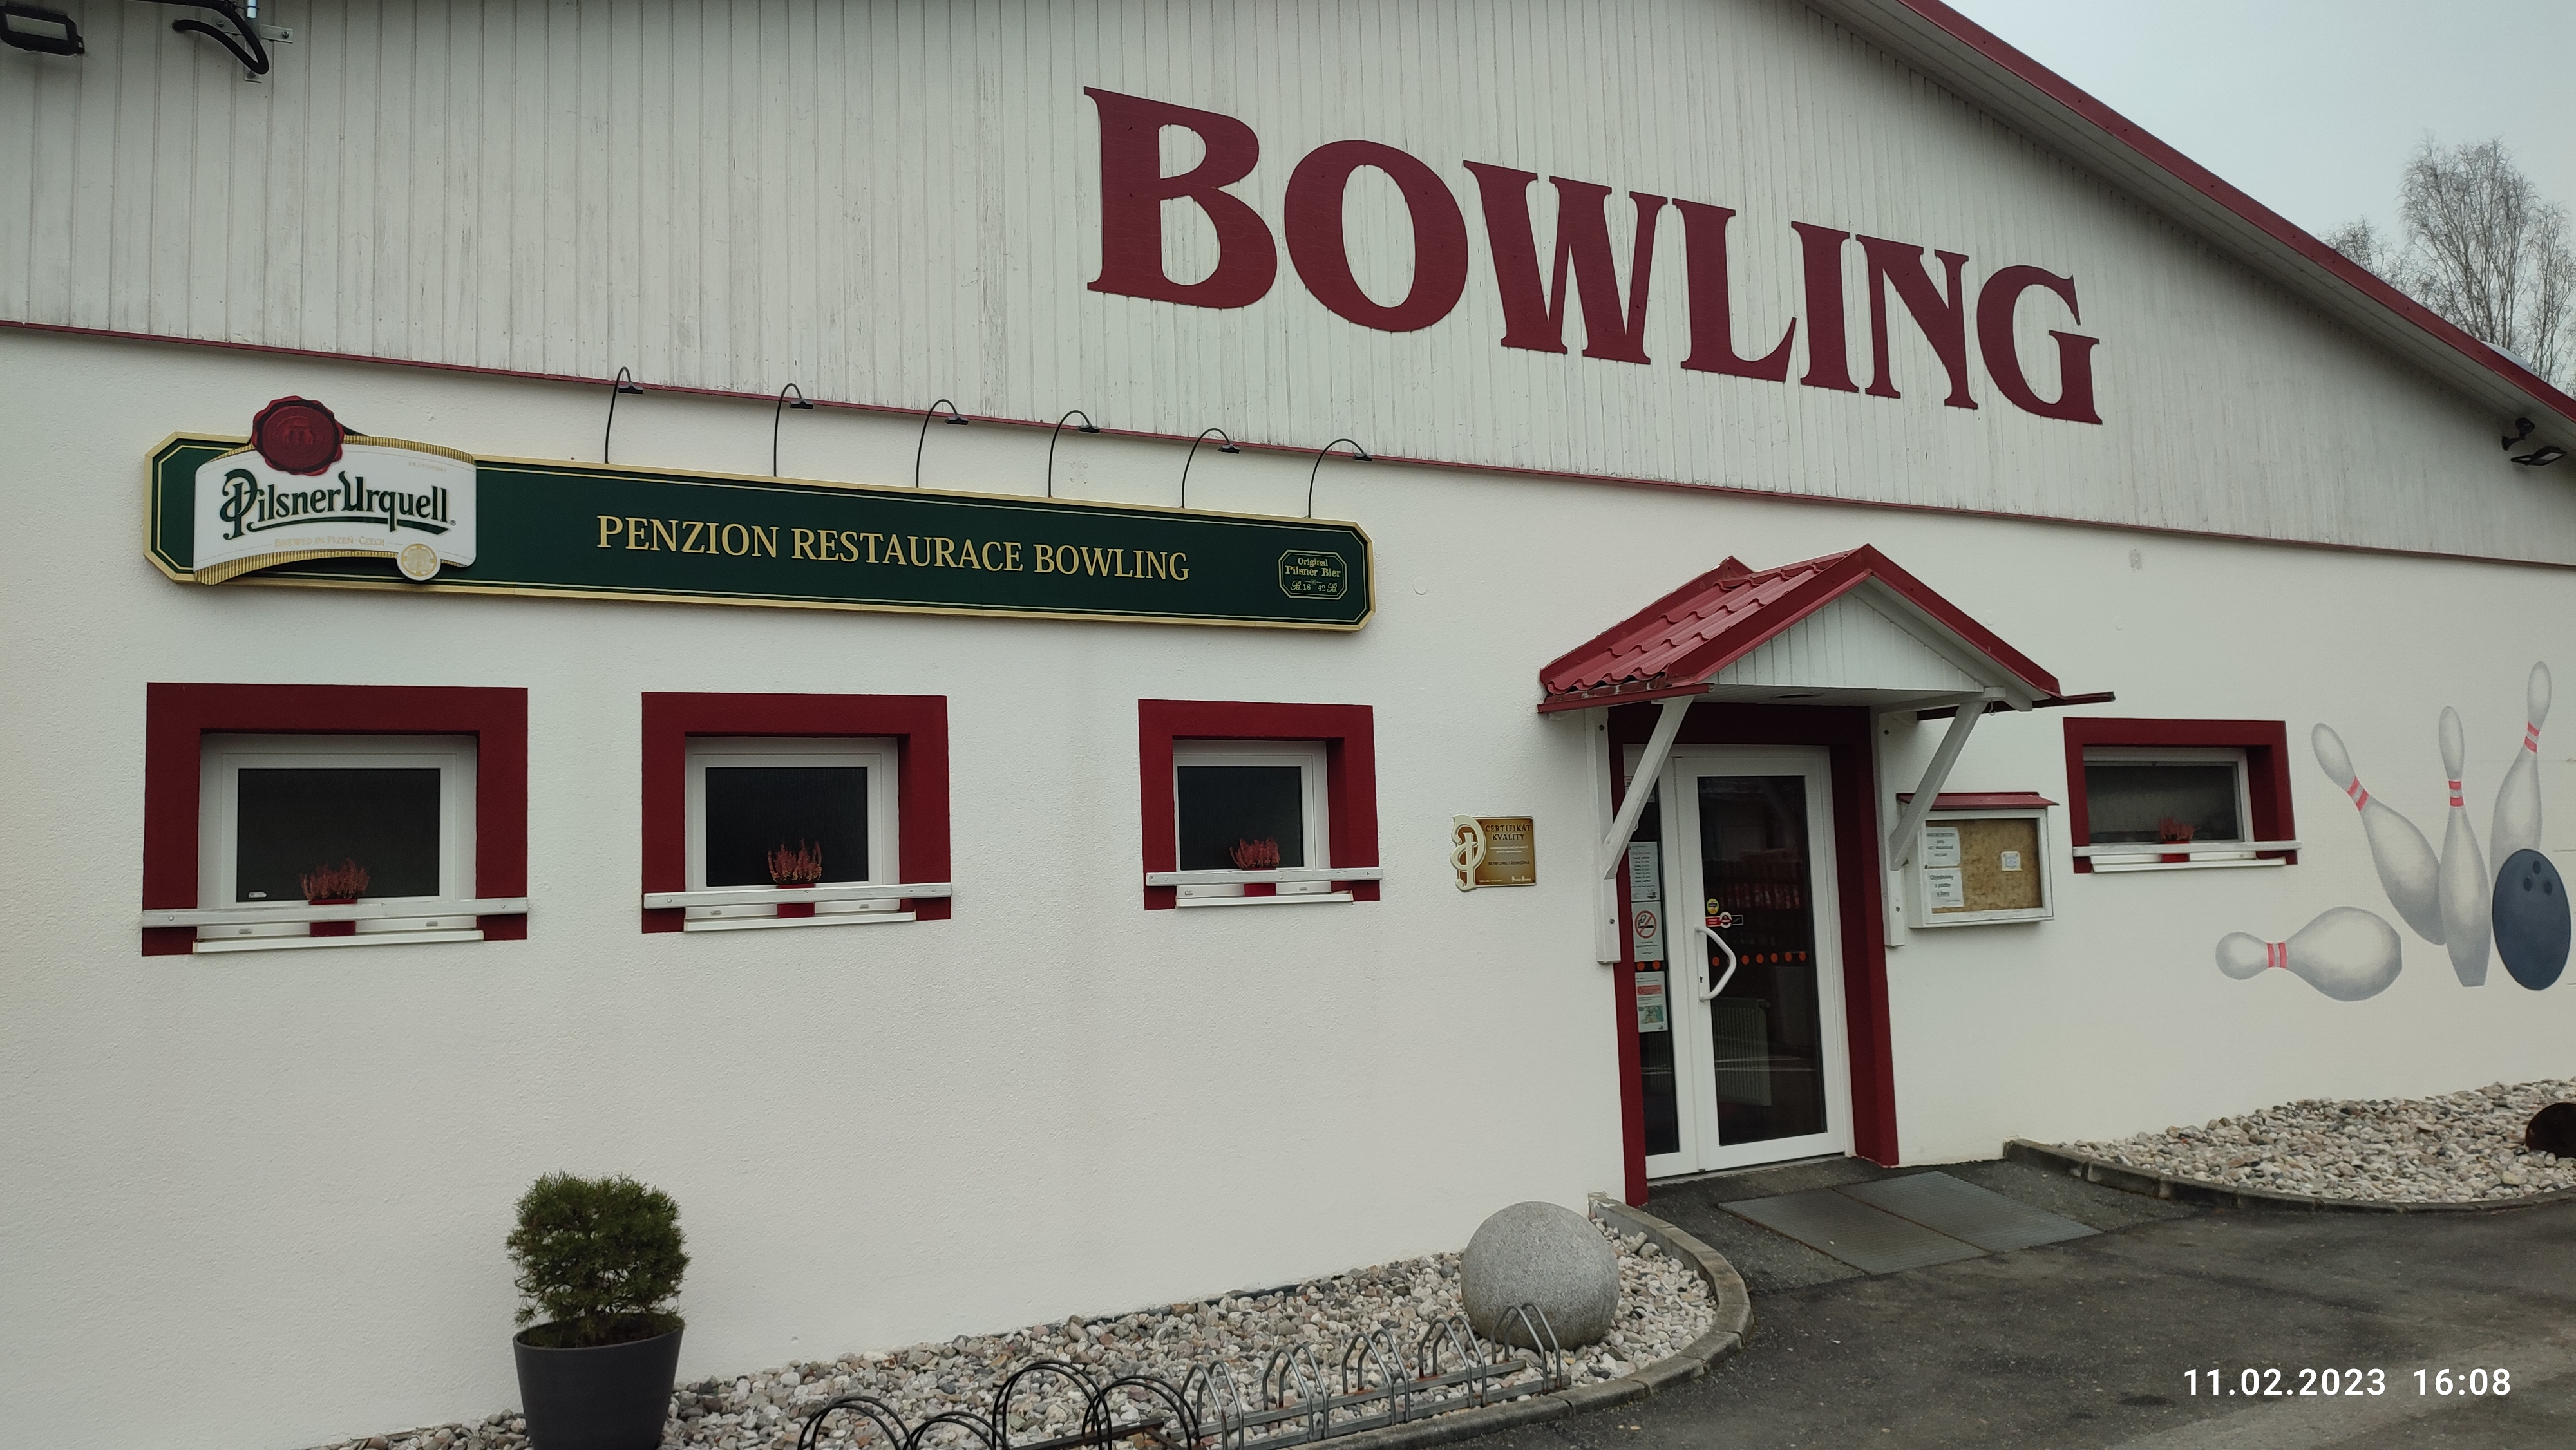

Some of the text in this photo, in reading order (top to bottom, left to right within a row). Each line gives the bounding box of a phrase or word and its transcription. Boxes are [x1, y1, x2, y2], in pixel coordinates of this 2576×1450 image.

[1083, 86, 2102, 425] BOWLING
[220, 469, 448, 540] Pilsner Urquell
[596, 515, 1190, 581] PENZION RESTAURACE BOWLING
[1297, 557, 1329, 567] Original
[1321, 567, 1341, 578] Bier
[1485, 823, 1531, 833] CERTIFIKÁT
